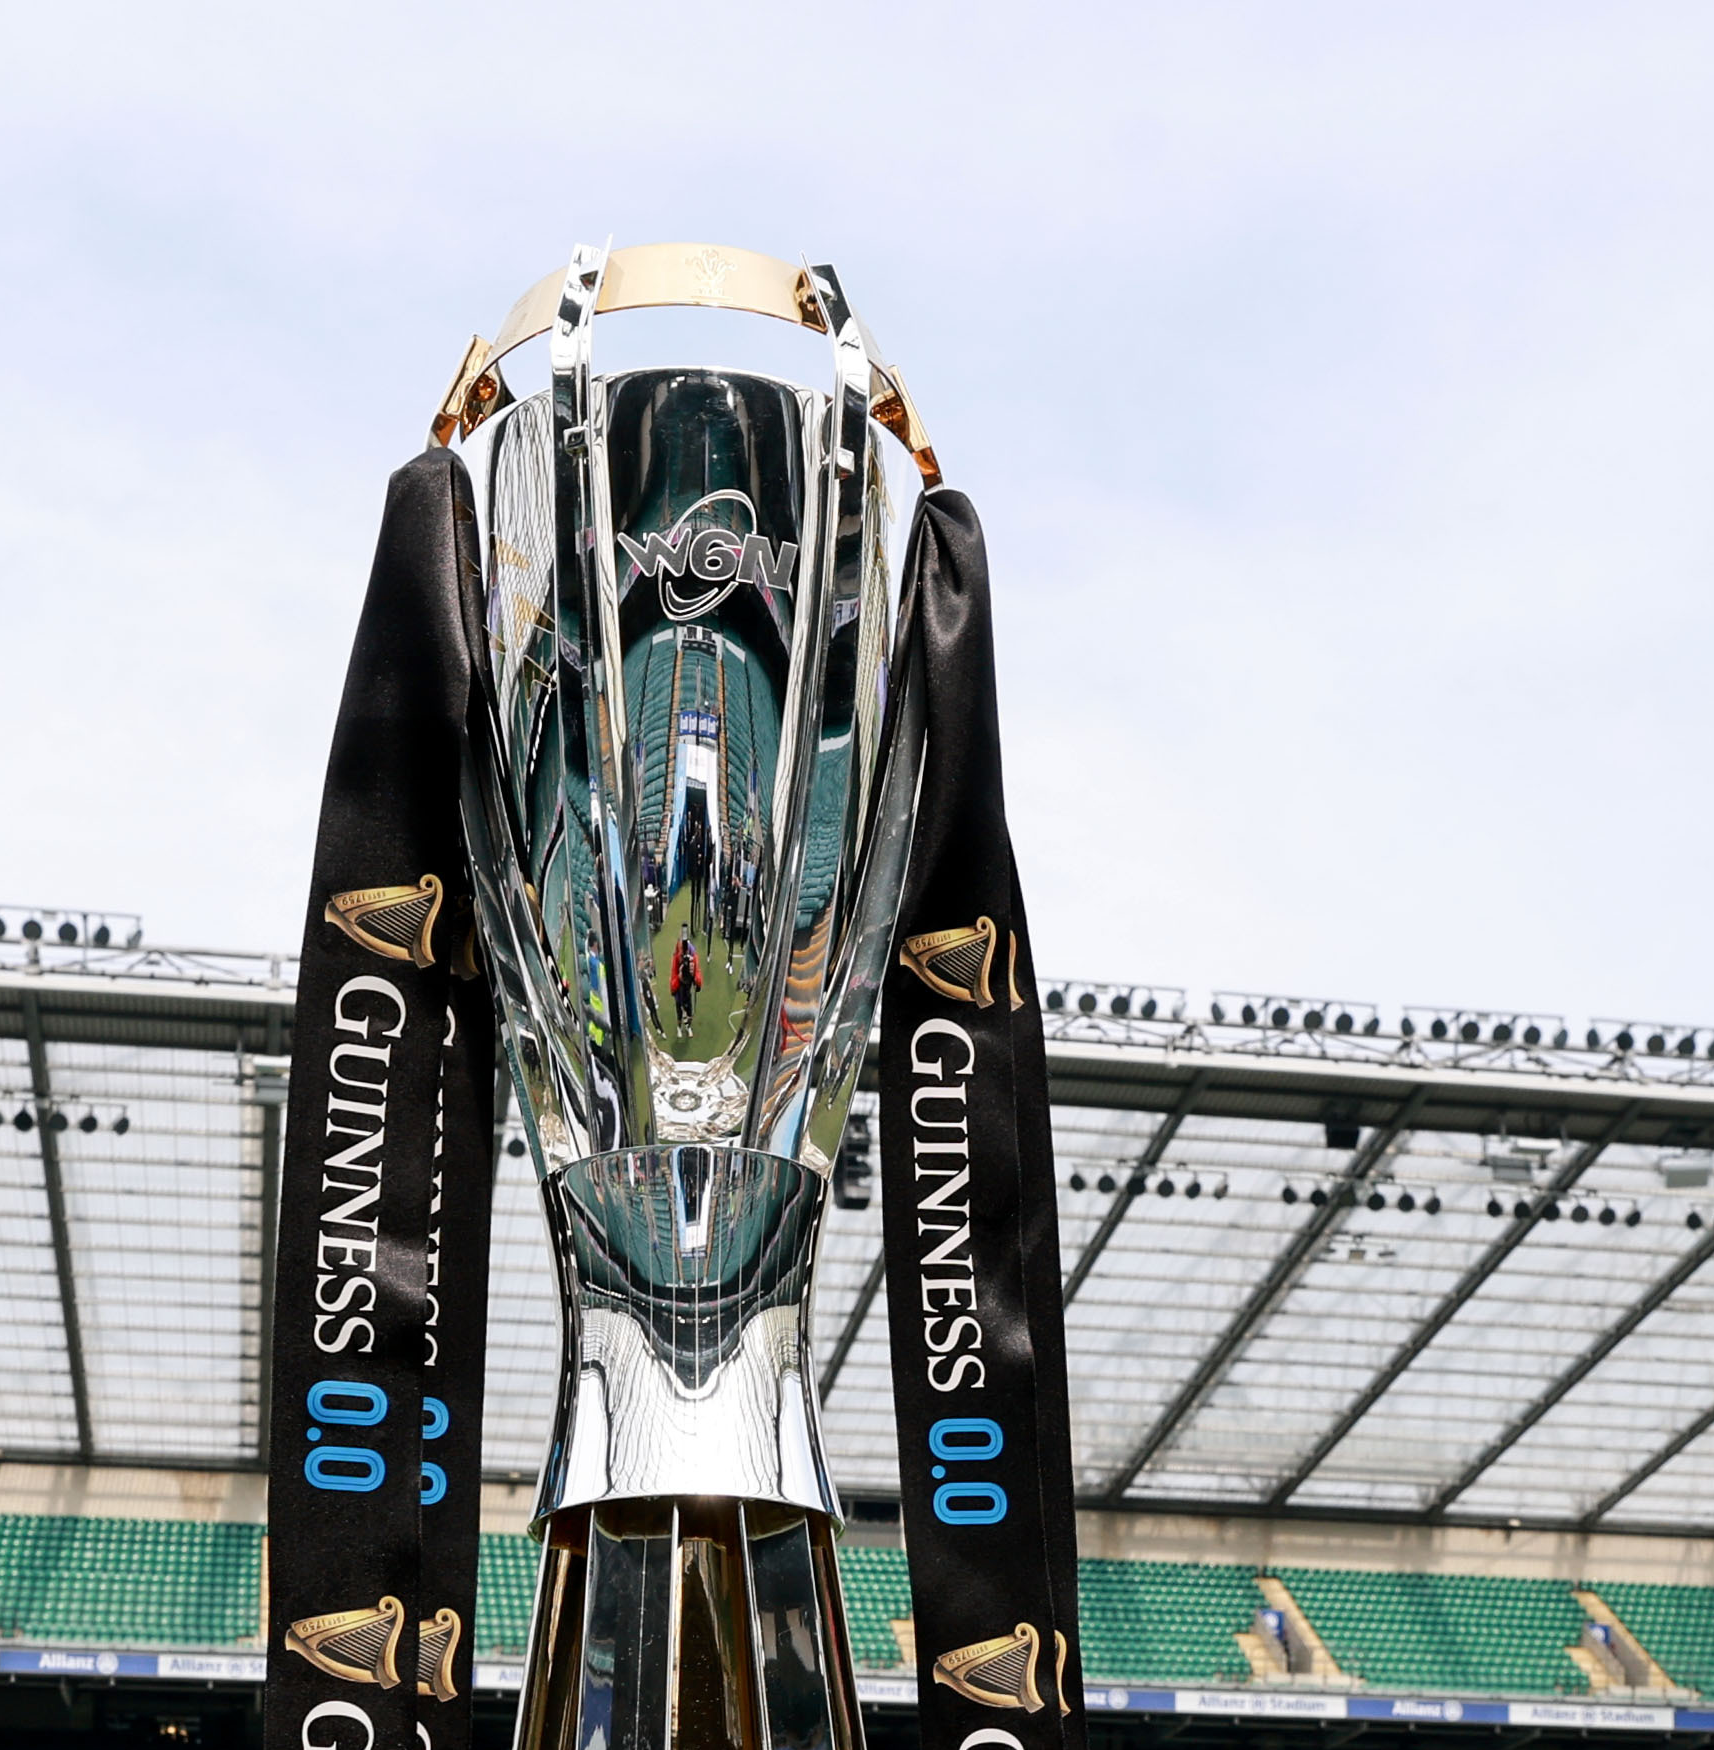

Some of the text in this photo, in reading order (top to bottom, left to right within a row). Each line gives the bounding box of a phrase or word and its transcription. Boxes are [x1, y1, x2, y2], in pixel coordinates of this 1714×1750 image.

[617, 527, 799, 592] W6N
[313, 974, 407, 1354] GUINNESS
[910, 1017, 1008, 1525] GUINNESS 0.0
[304, 1379, 388, 1491] 0.0
[40, 1653, 95, 1671] Allianz
[1393, 1700, 1442, 1717] Allianz
